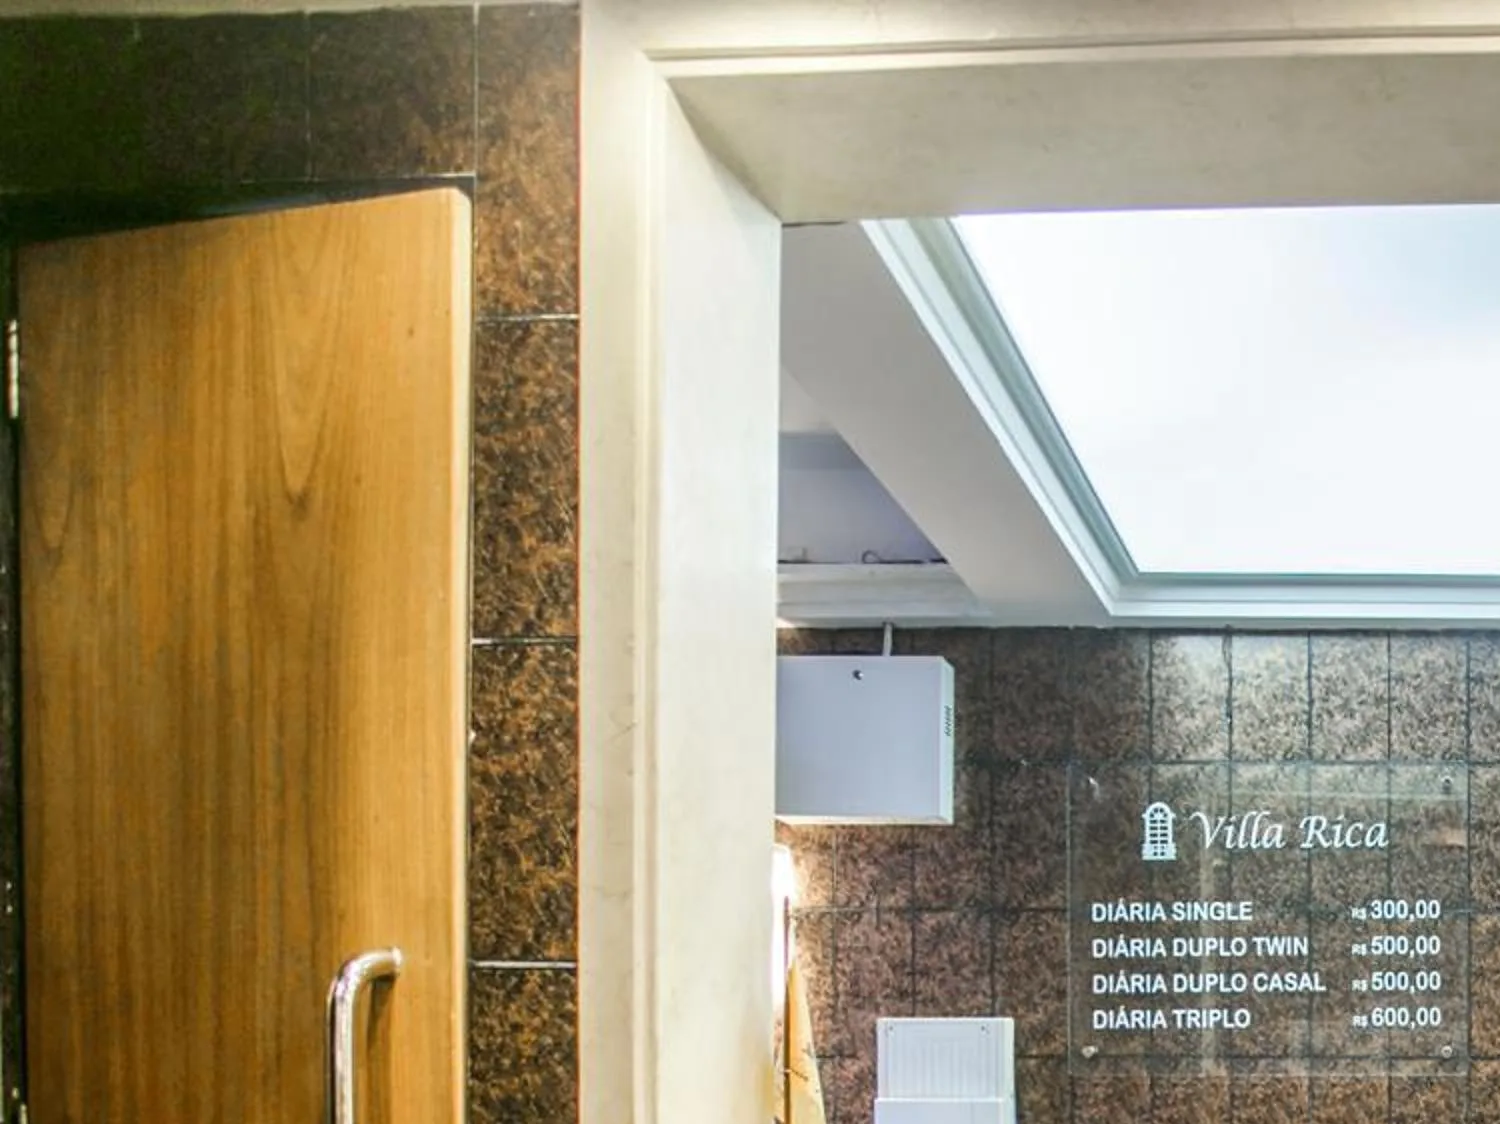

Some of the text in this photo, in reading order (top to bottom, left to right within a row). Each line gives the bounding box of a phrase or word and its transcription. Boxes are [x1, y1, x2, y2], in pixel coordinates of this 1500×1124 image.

[1188, 811, 1390, 850] Villa Rica
[1091, 897, 1167, 923] DIÁRIA
[1171, 901, 1253, 921] SINGLE
[1370, 899, 1441, 922] 300,00
[1092, 933, 1167, 959] DIÁRIA
[1172, 936, 1248, 957] DUPLO
[1252, 935, 1309, 957] TWIN
[1371, 935, 1441, 958] 500,00
[1092, 969, 1168, 994] DIÁRIA
[1172, 972, 1248, 993] DUPLO
[1252, 971, 1328, 993] CASAL
[1371, 971, 1442, 994] 500,00
[1092, 1005, 1168, 1029] DIÁRIA
[1171, 1008, 1251, 1028] TRIPLO
[1371, 1007, 1442, 1030] 600,00
